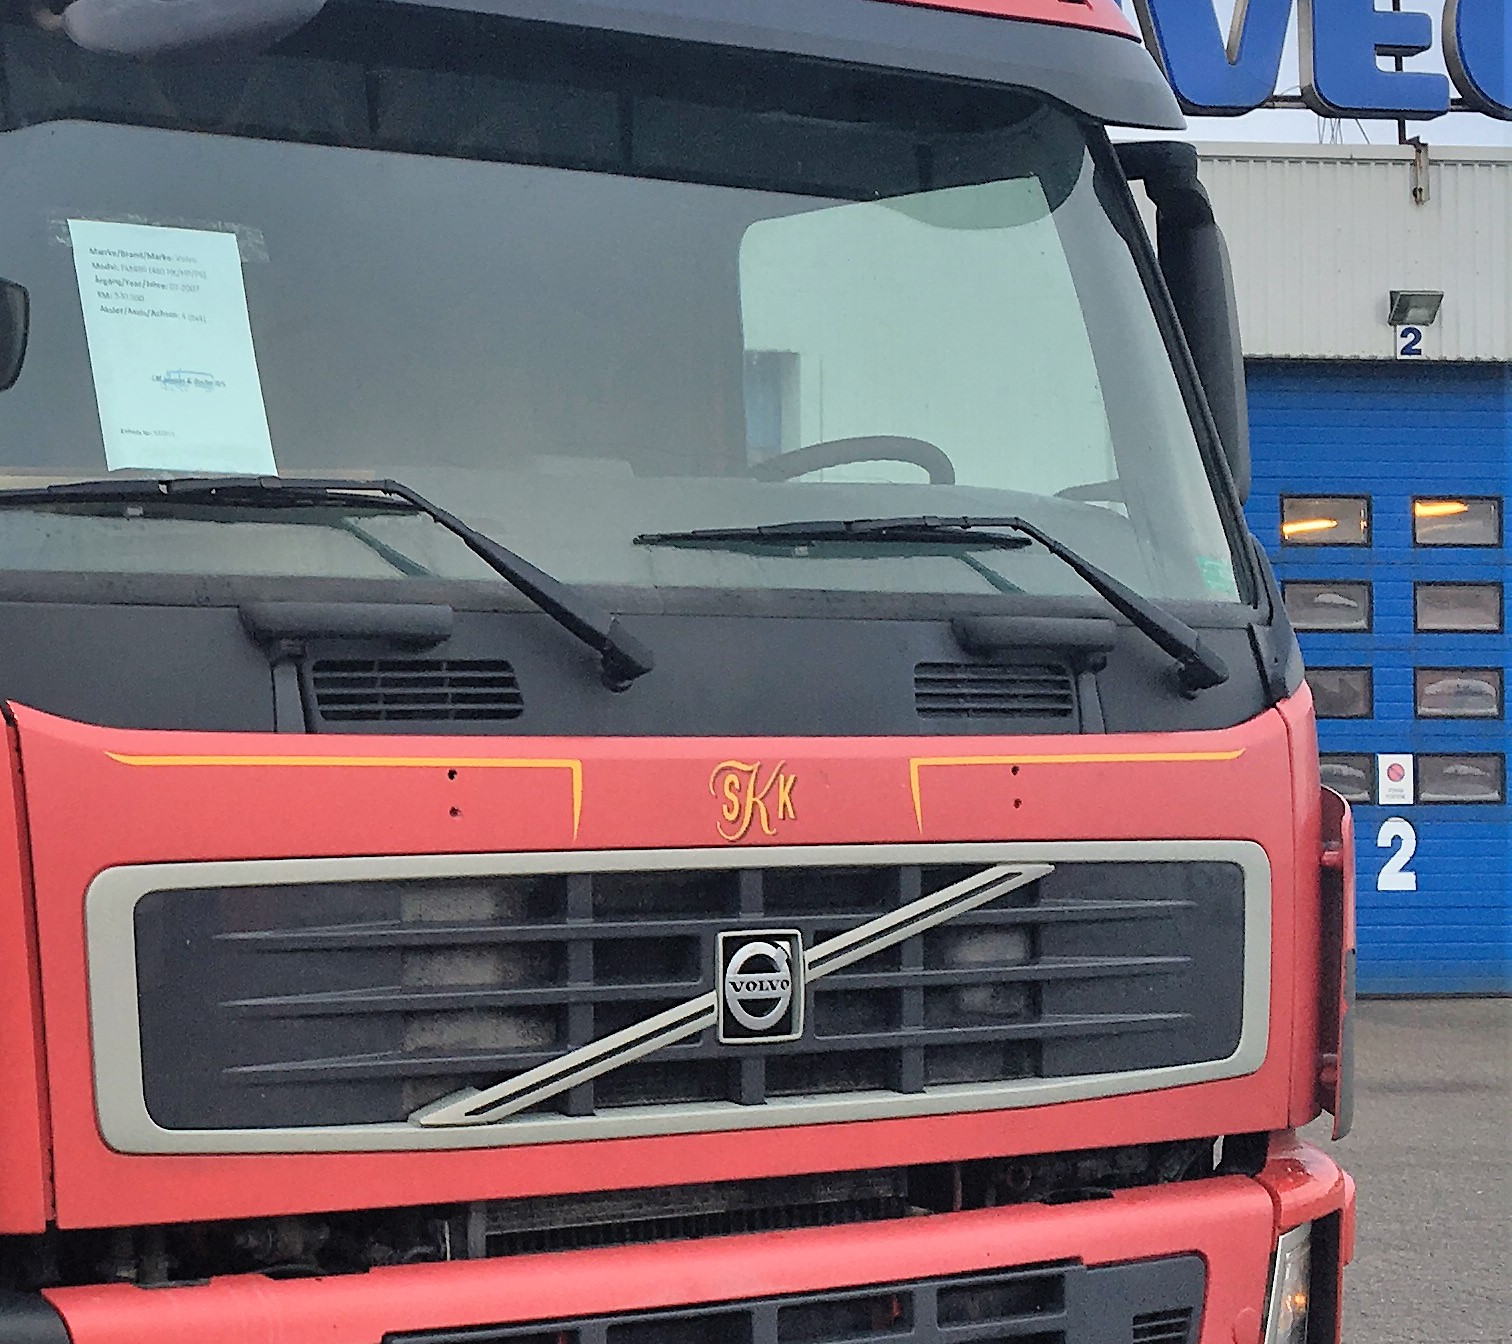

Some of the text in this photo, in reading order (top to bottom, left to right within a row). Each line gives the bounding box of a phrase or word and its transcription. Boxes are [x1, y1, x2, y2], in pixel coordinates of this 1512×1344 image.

[1400, 327, 1422, 356] 2
[1377, 817, 1418, 891] 2
[728, 978, 790, 994] VOLVO
